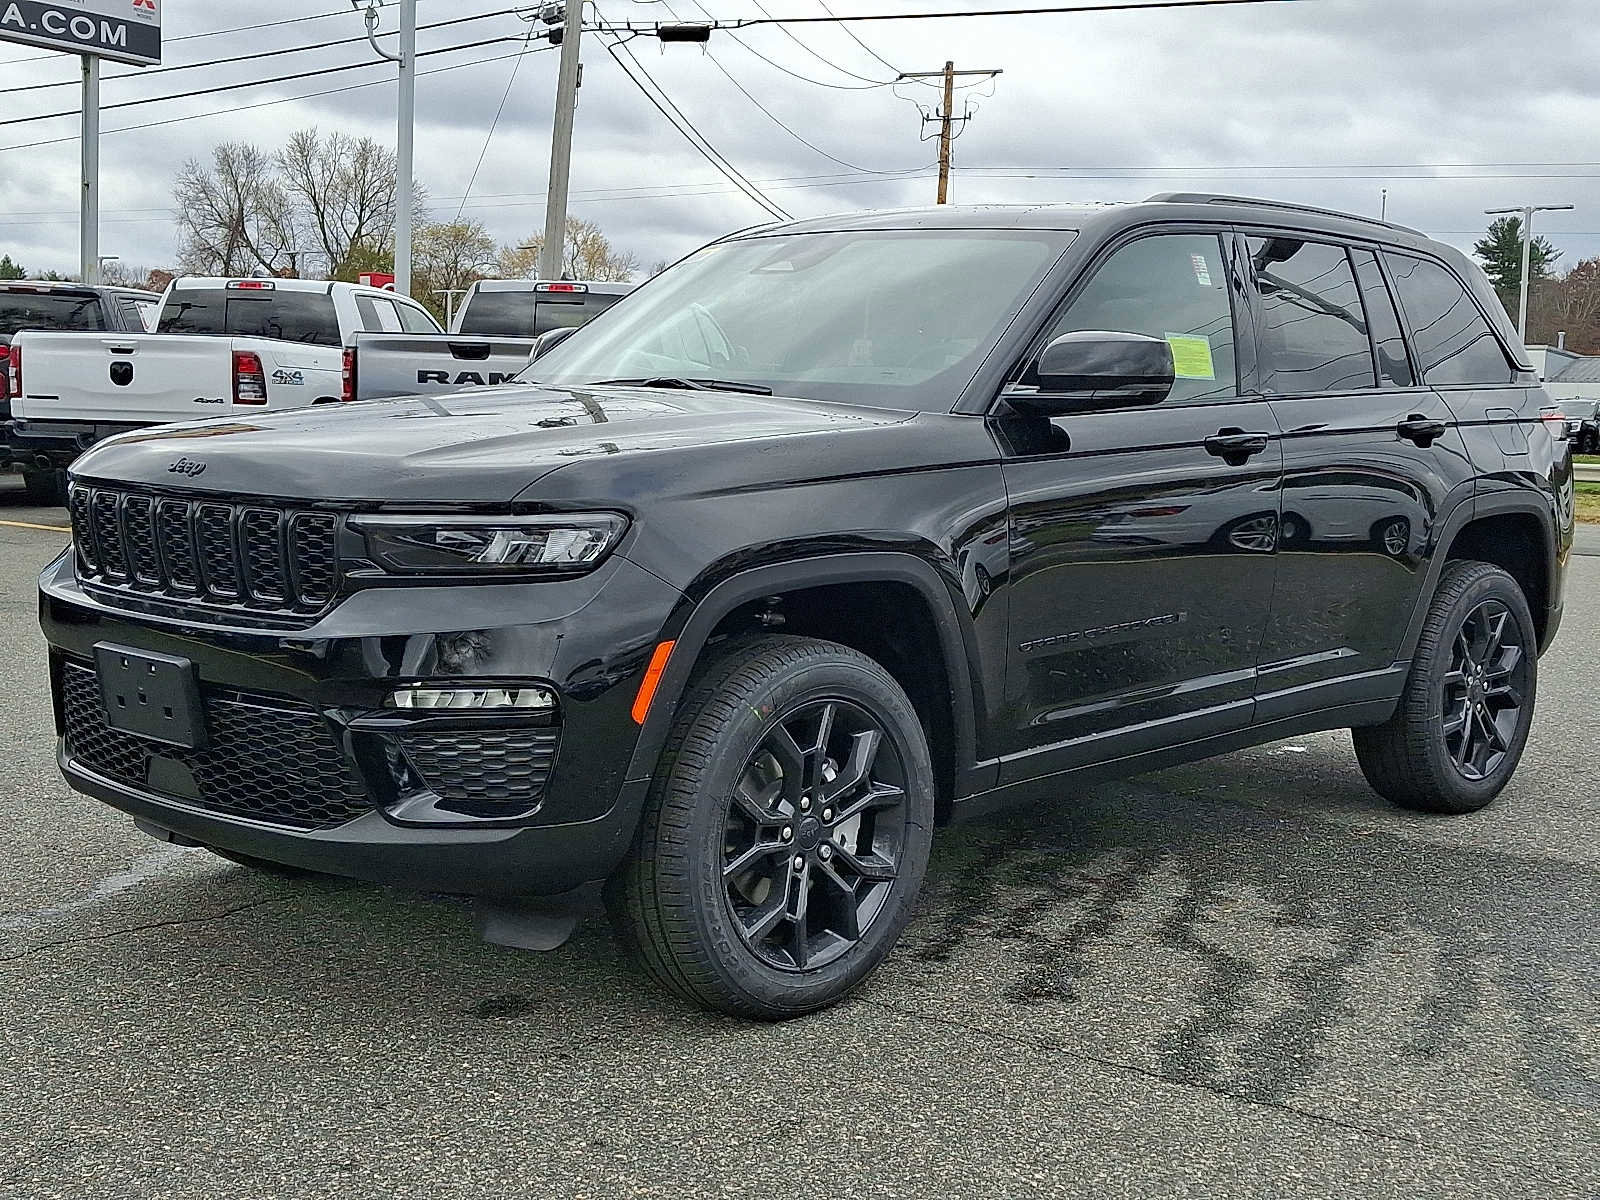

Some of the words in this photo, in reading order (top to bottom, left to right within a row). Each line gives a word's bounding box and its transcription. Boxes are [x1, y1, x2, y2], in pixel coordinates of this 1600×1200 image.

[1, 3, 126, 46] A.COM
[417, 369, 517, 385] RAM
[168, 457, 207, 478] Jeep
